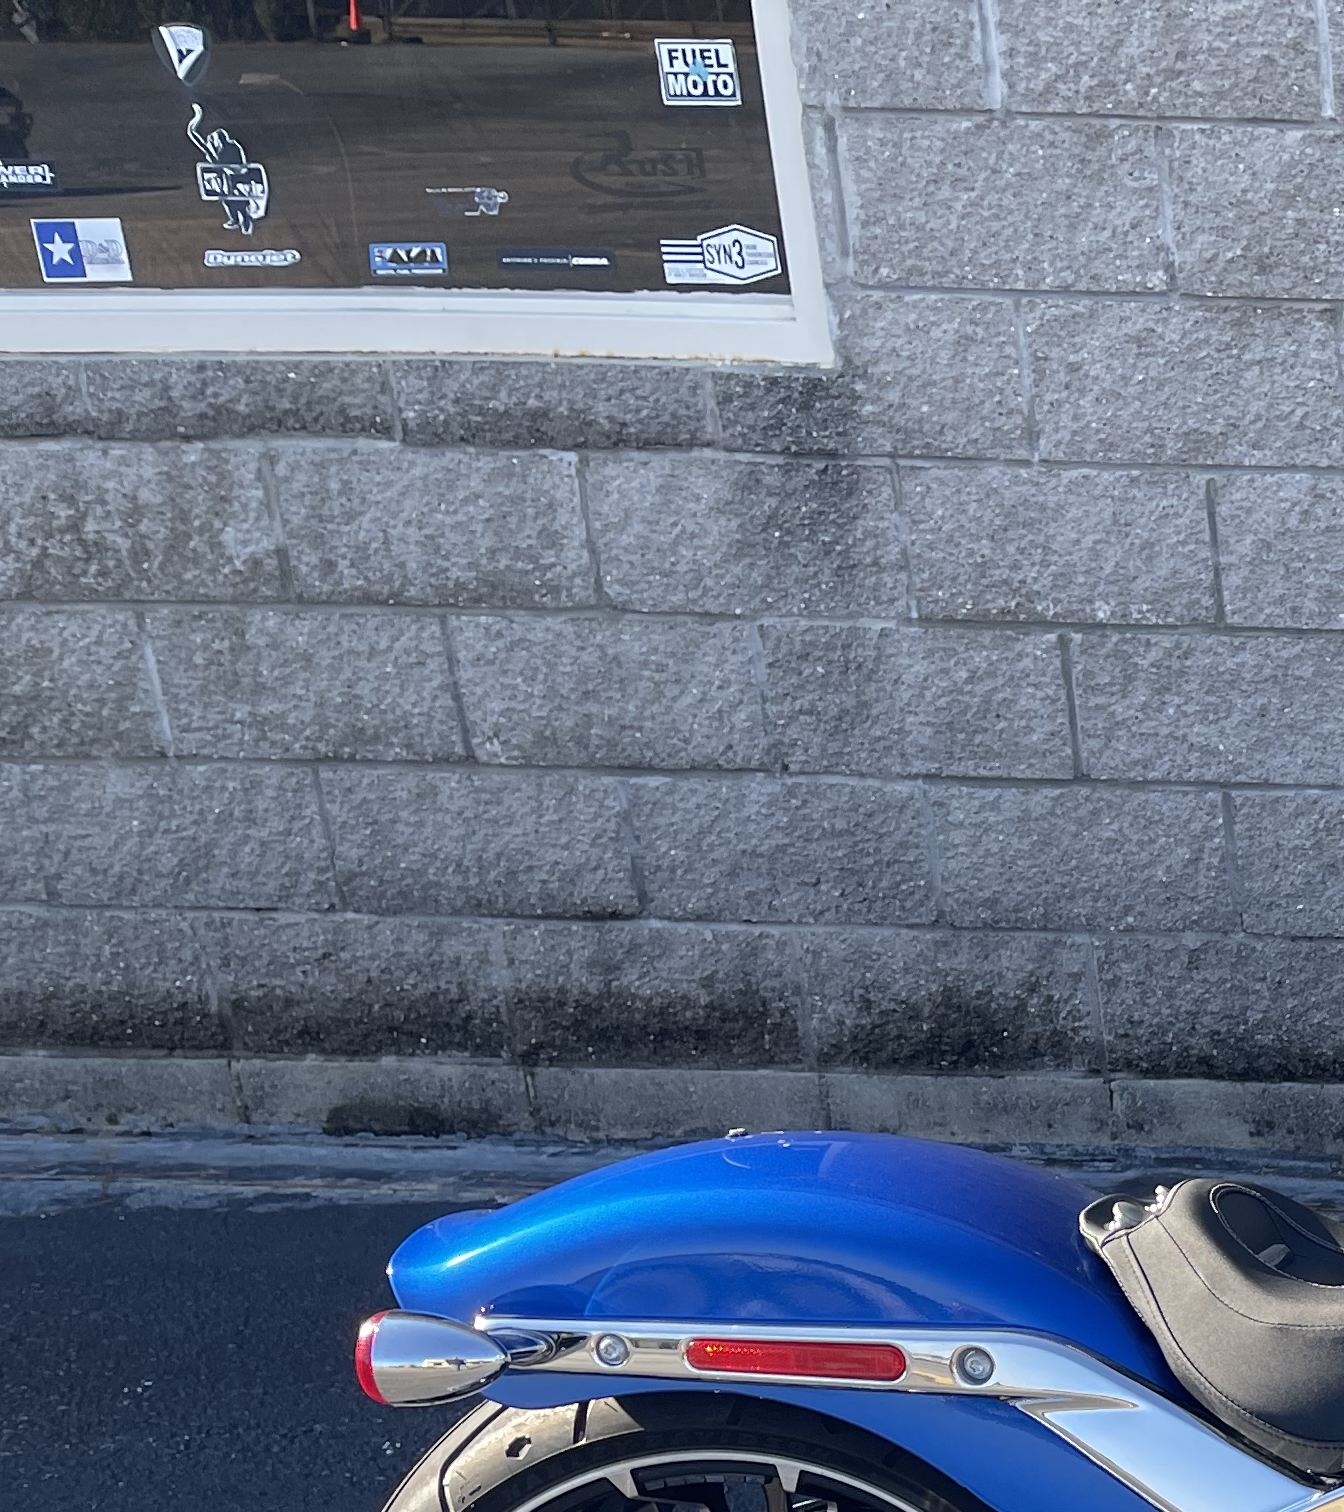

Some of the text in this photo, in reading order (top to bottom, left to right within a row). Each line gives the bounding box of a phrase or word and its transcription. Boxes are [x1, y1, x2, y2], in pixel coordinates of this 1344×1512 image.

[666, 48, 730, 69] FUEL
[667, 74, 735, 96] MOTO
[80, 239, 125, 264] D&D
[705, 239, 745, 270] SYN3
